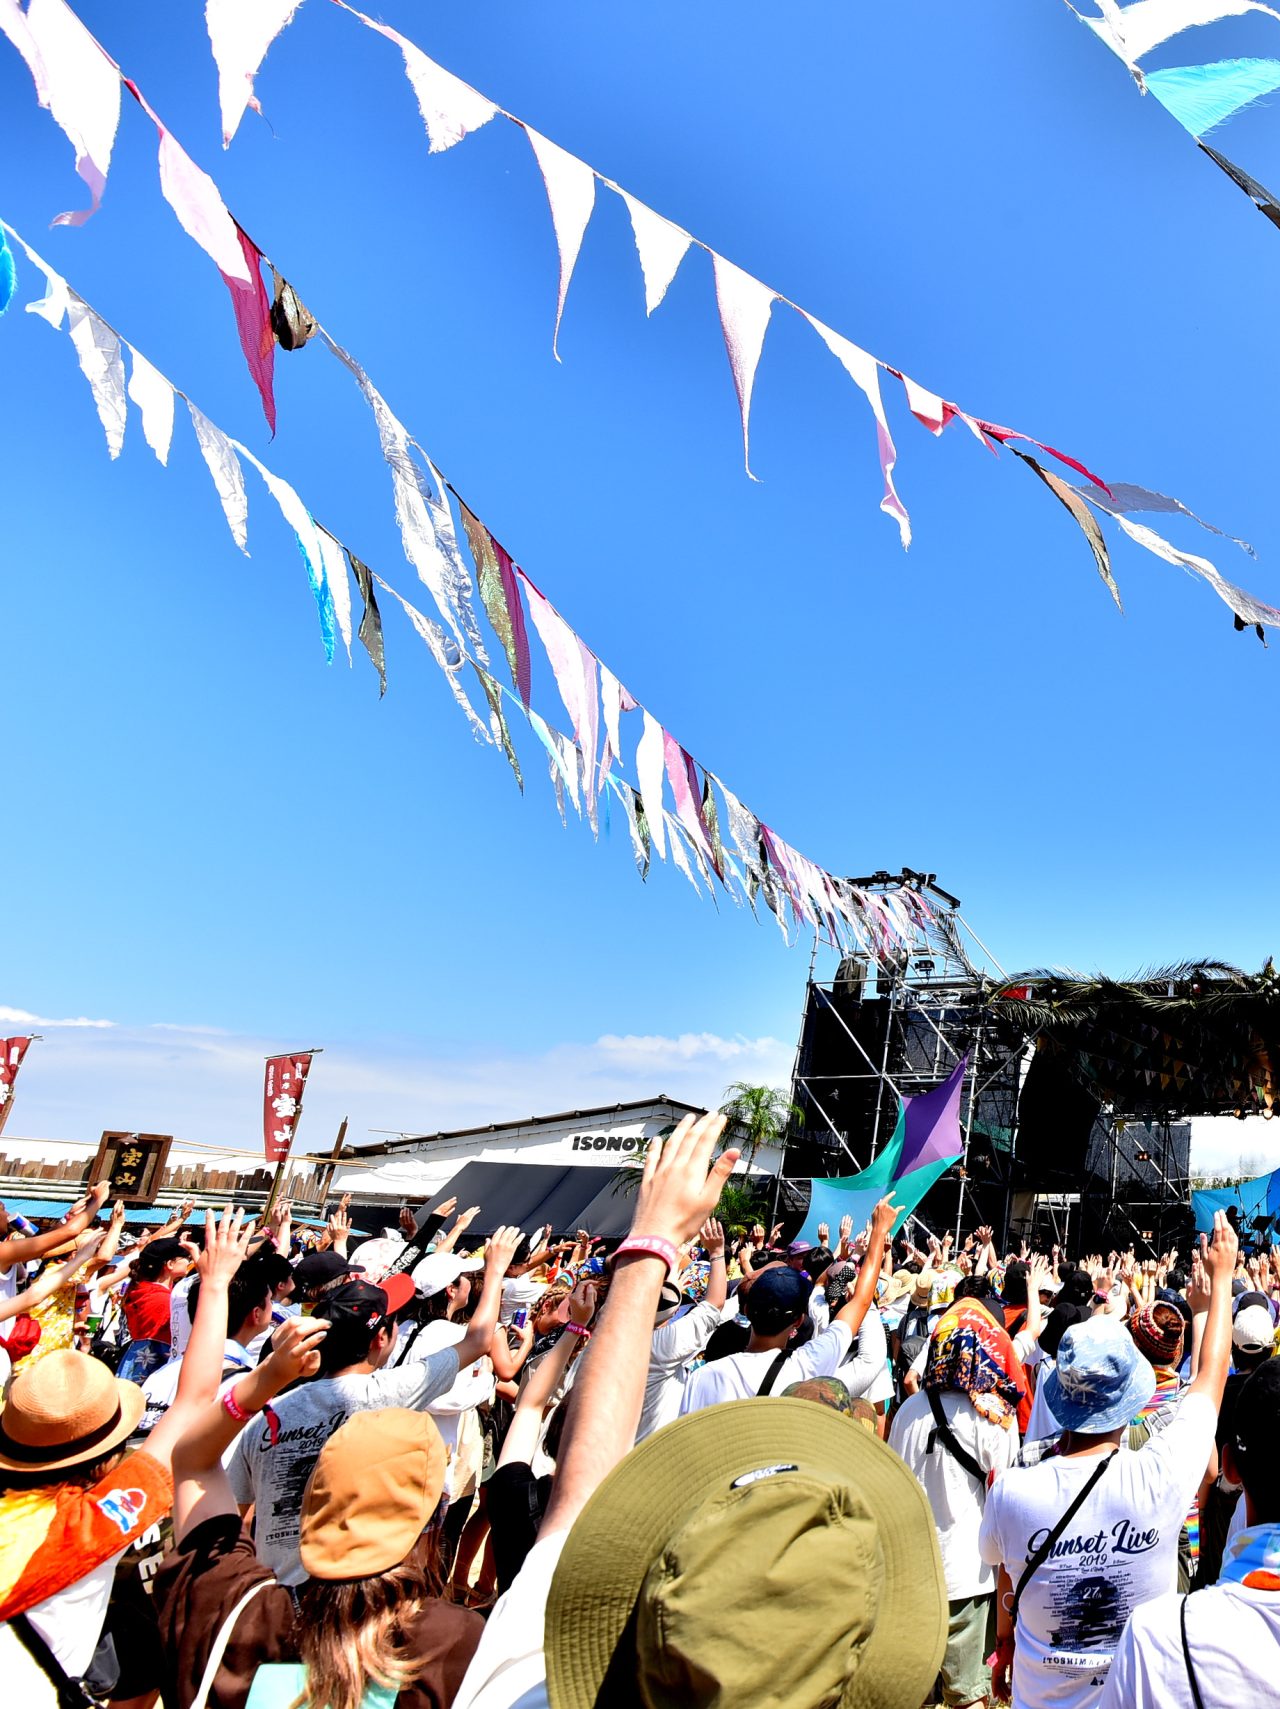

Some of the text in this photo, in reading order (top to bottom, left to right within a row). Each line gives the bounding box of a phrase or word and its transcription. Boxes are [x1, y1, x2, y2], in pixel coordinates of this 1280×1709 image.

[572, 1136, 652, 1151] ISONOY
[115, 1148, 143, 1186] 宝山
[1025, 1519, 1160, 1565] Sunset Live
[1079, 1553, 1108, 1567] 2019
